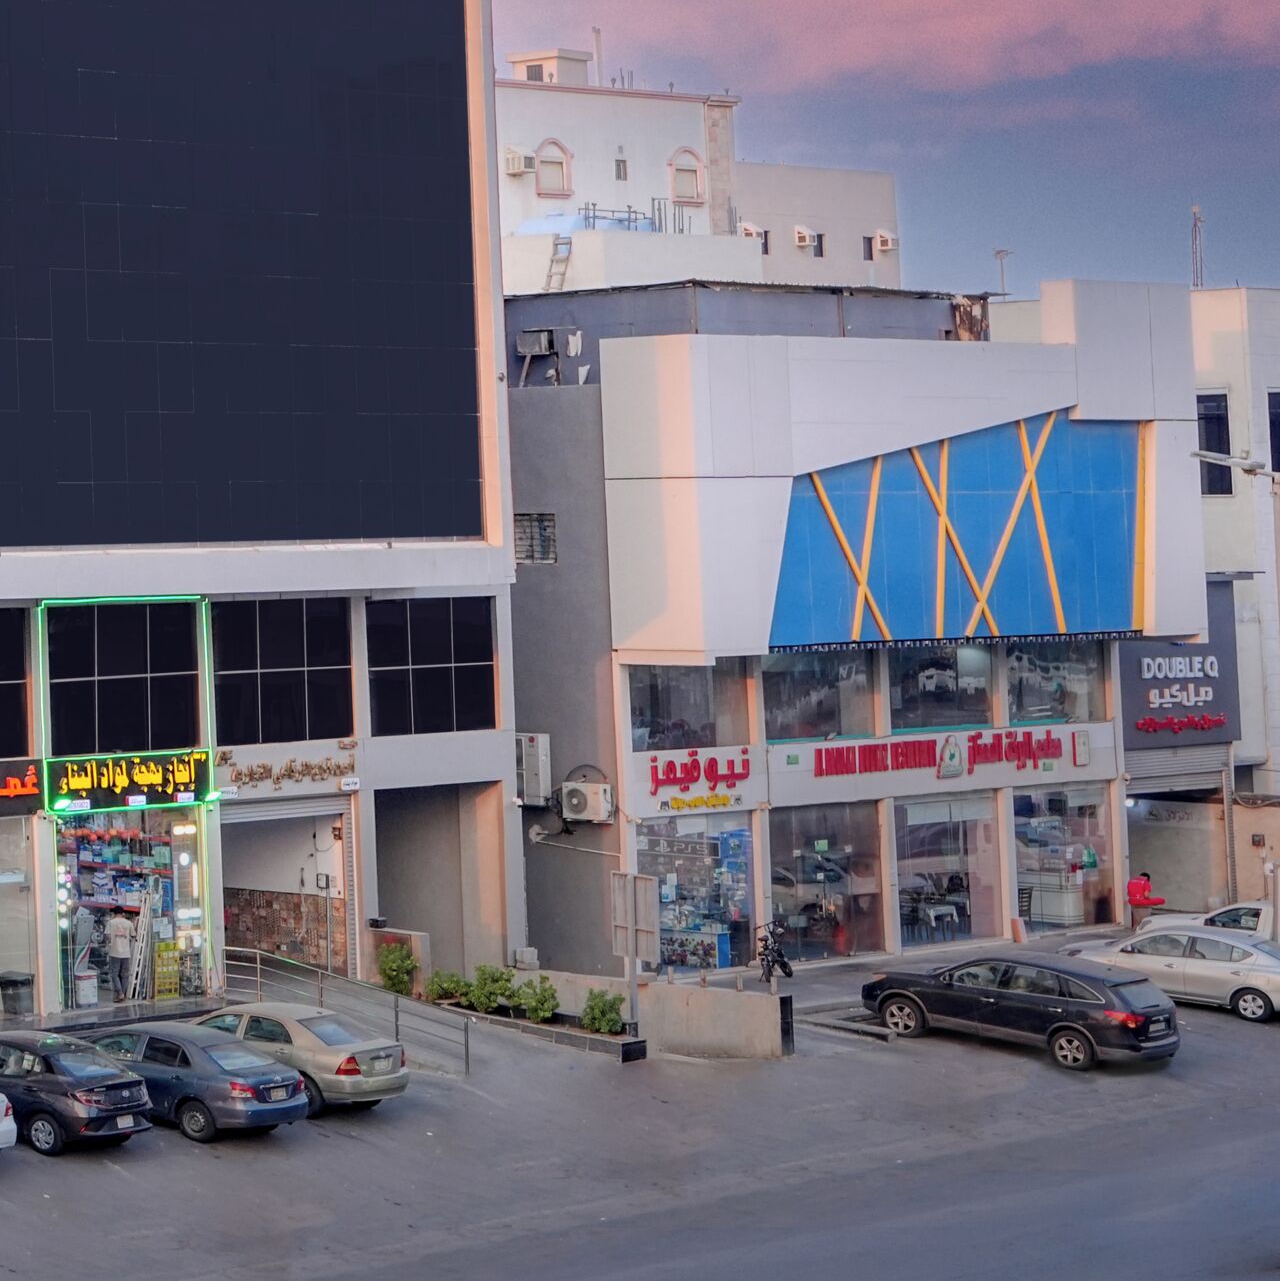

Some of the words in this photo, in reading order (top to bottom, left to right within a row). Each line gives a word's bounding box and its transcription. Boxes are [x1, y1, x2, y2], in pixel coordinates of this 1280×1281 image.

[1141, 656, 1204, 679] DOUBLE
[1204, 655, 1219, 678] Q
[59, 759, 98, 798] البناء
[131, 756, 163, 793] بهجة
[165, 752, 196, 795] إنجاز
[649, 749, 702, 797] قيمز
[704, 746, 750, 792] نيو
